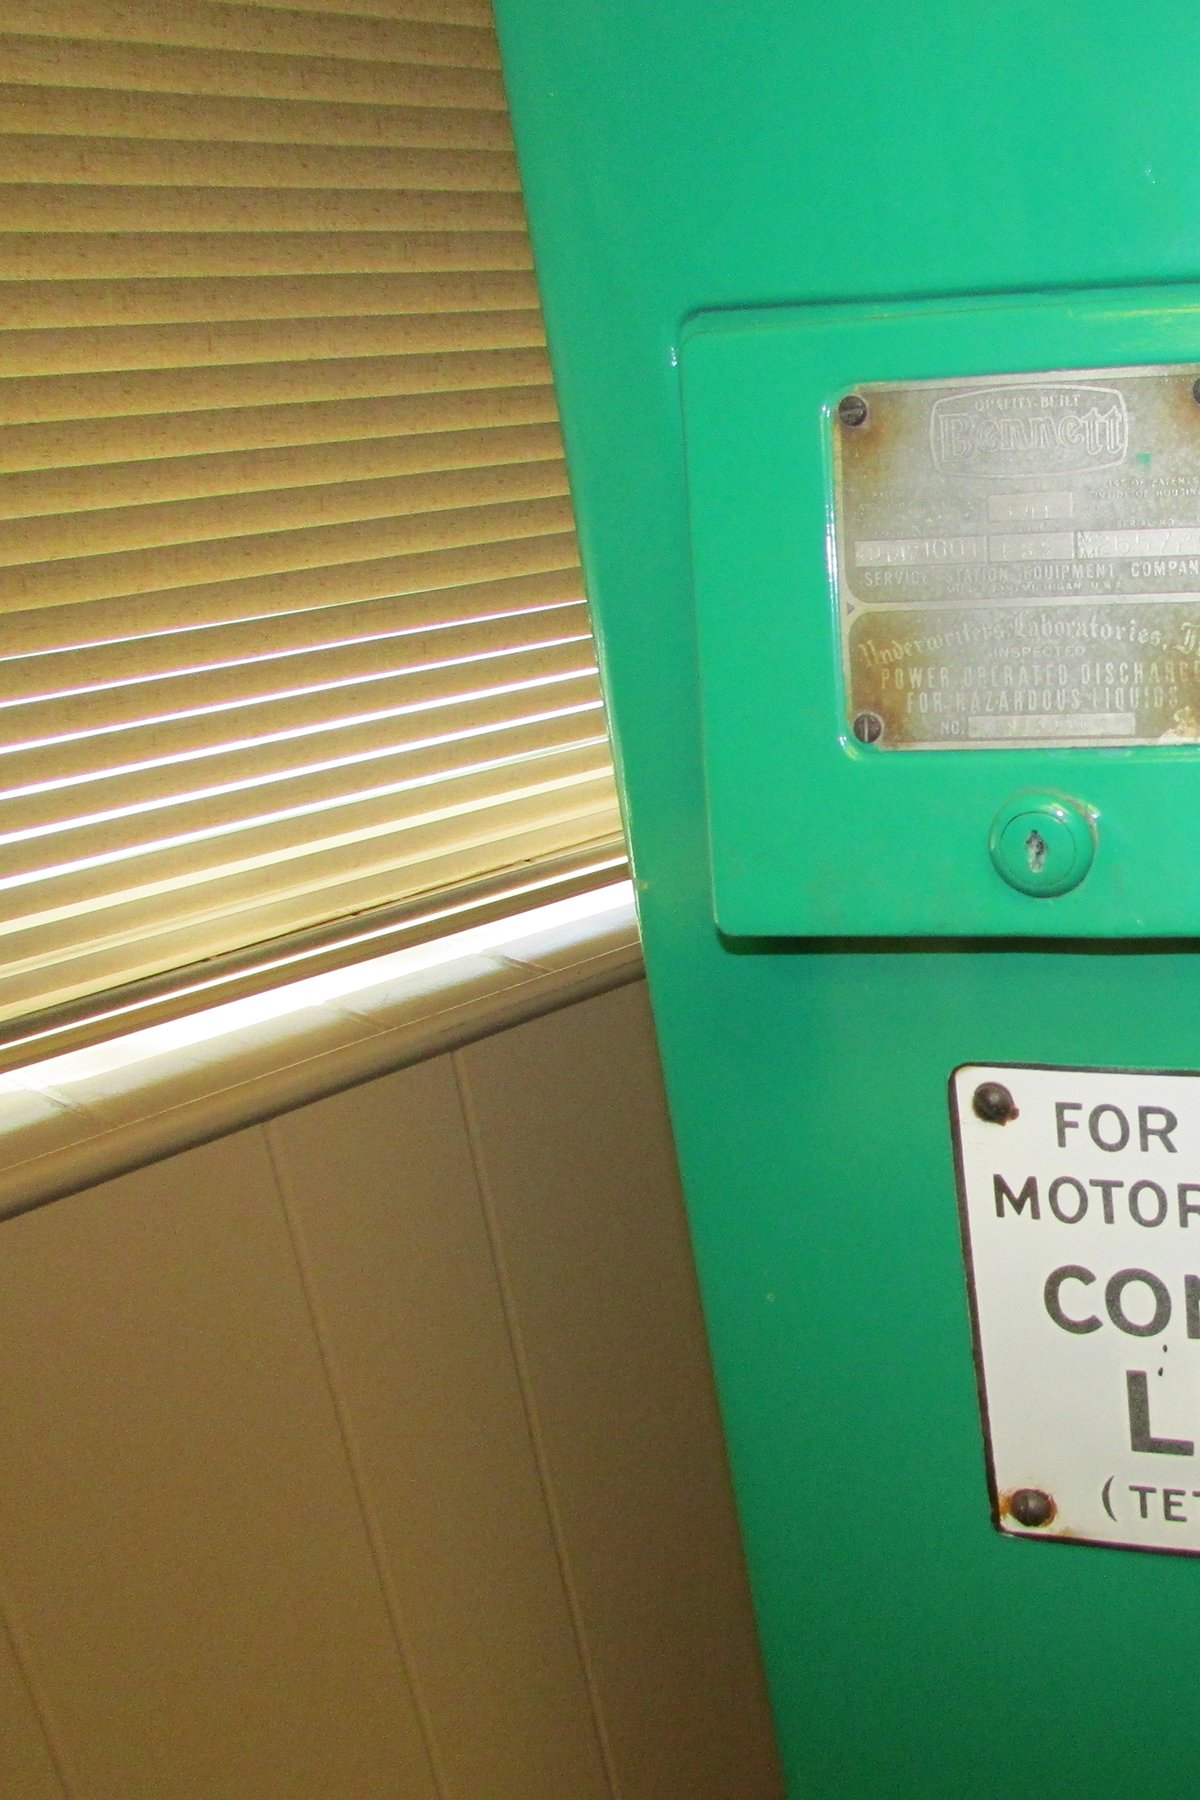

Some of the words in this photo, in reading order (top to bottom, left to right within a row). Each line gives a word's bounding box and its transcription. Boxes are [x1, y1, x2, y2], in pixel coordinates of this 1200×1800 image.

[938, 406, 1125, 463] Bennett
[881, 666, 950, 690] POWER
[963, 663, 1068, 689] OPERATED
[907, 691, 942, 714] FOR
[956, 688, 1081, 713] HAZARDOUS
[1056, 1103, 1177, 1152] FOR
